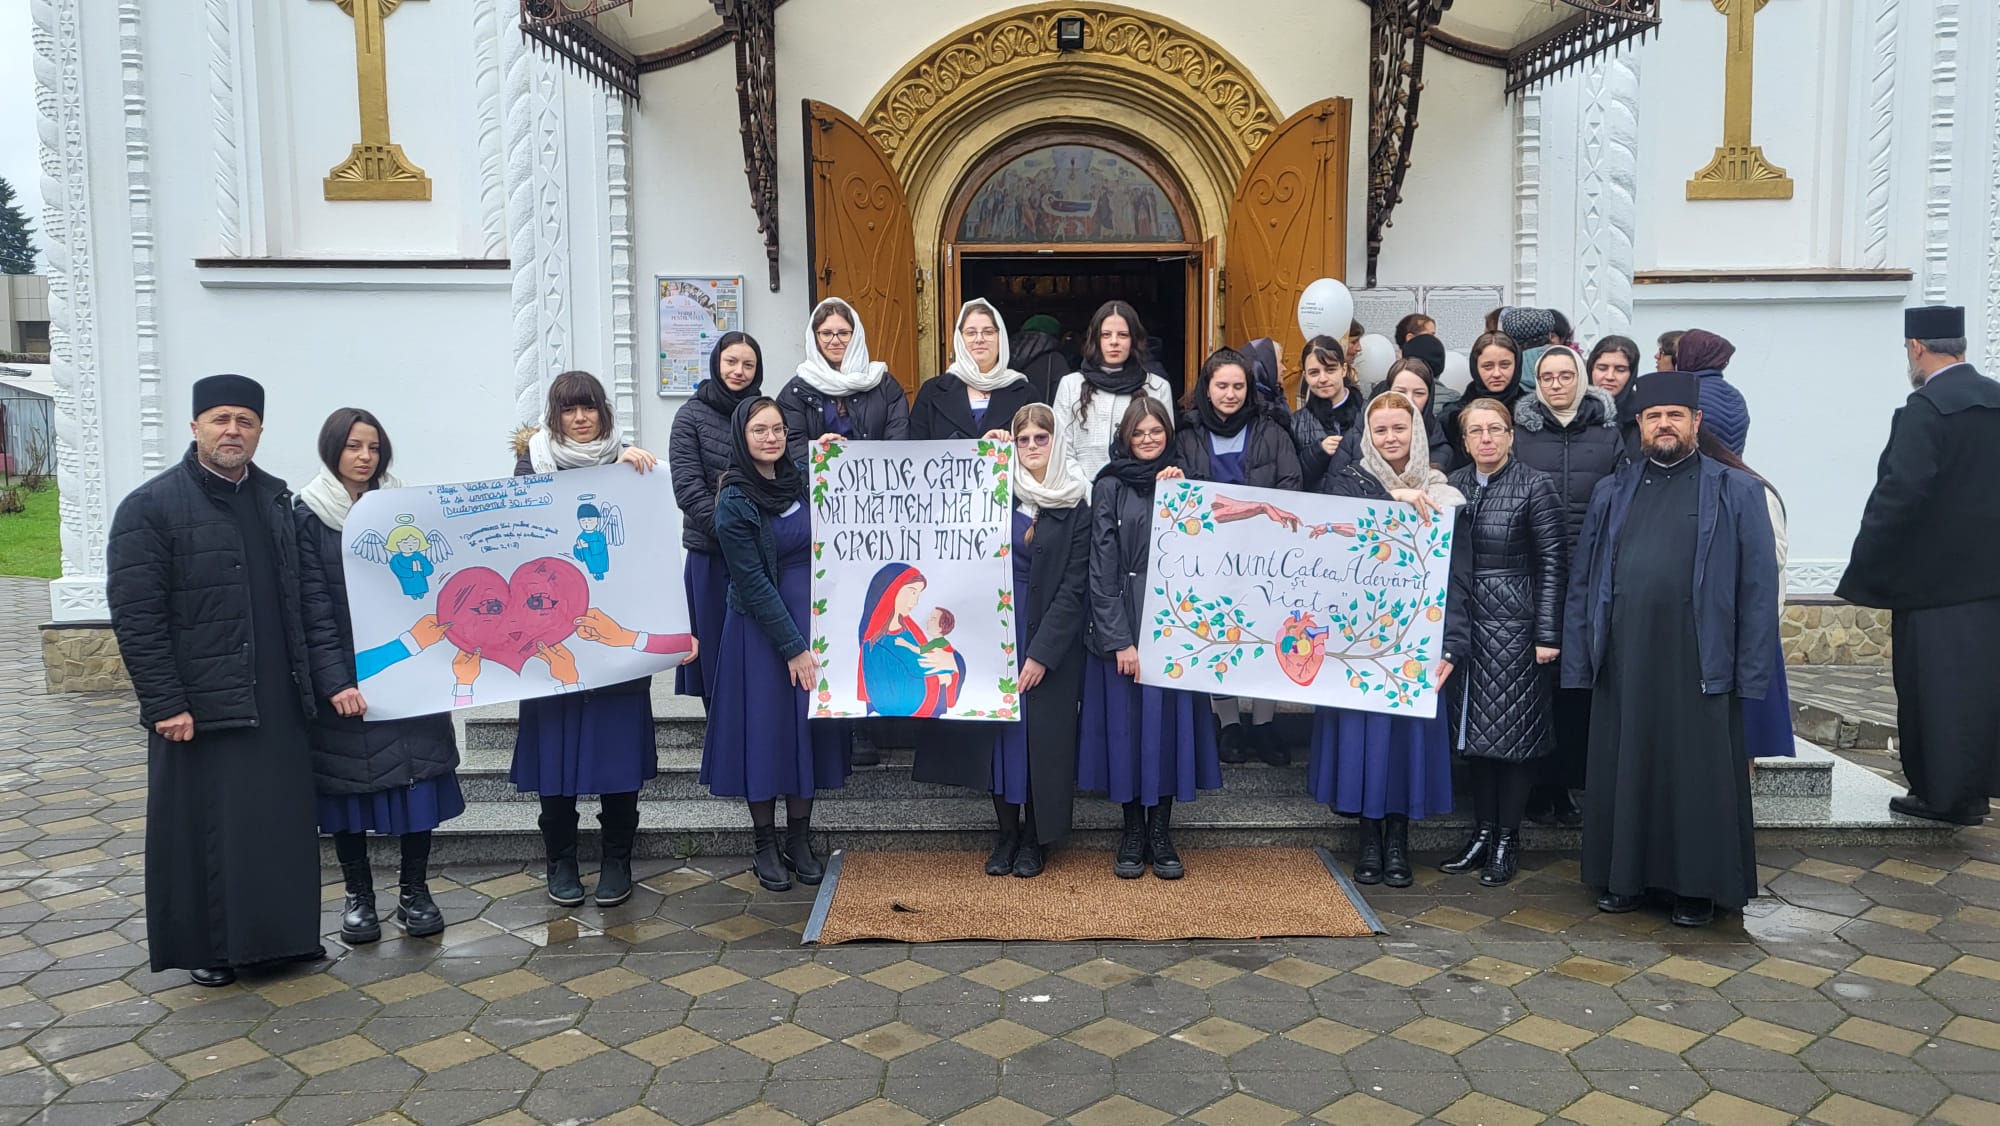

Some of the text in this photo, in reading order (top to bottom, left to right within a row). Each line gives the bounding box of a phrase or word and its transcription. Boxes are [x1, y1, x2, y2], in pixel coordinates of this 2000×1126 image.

[884, 457, 916, 491] DE
[923, 451, 986, 490] CÂTE
[854, 490, 885, 524] MĂ
[940, 489, 973, 523] MĂ
[833, 529, 894, 560] CRED
[899, 525, 921, 560] ÎN
[1214, 549, 1279, 578] sunt
[1340, 553, 1431, 591] Adevărul
